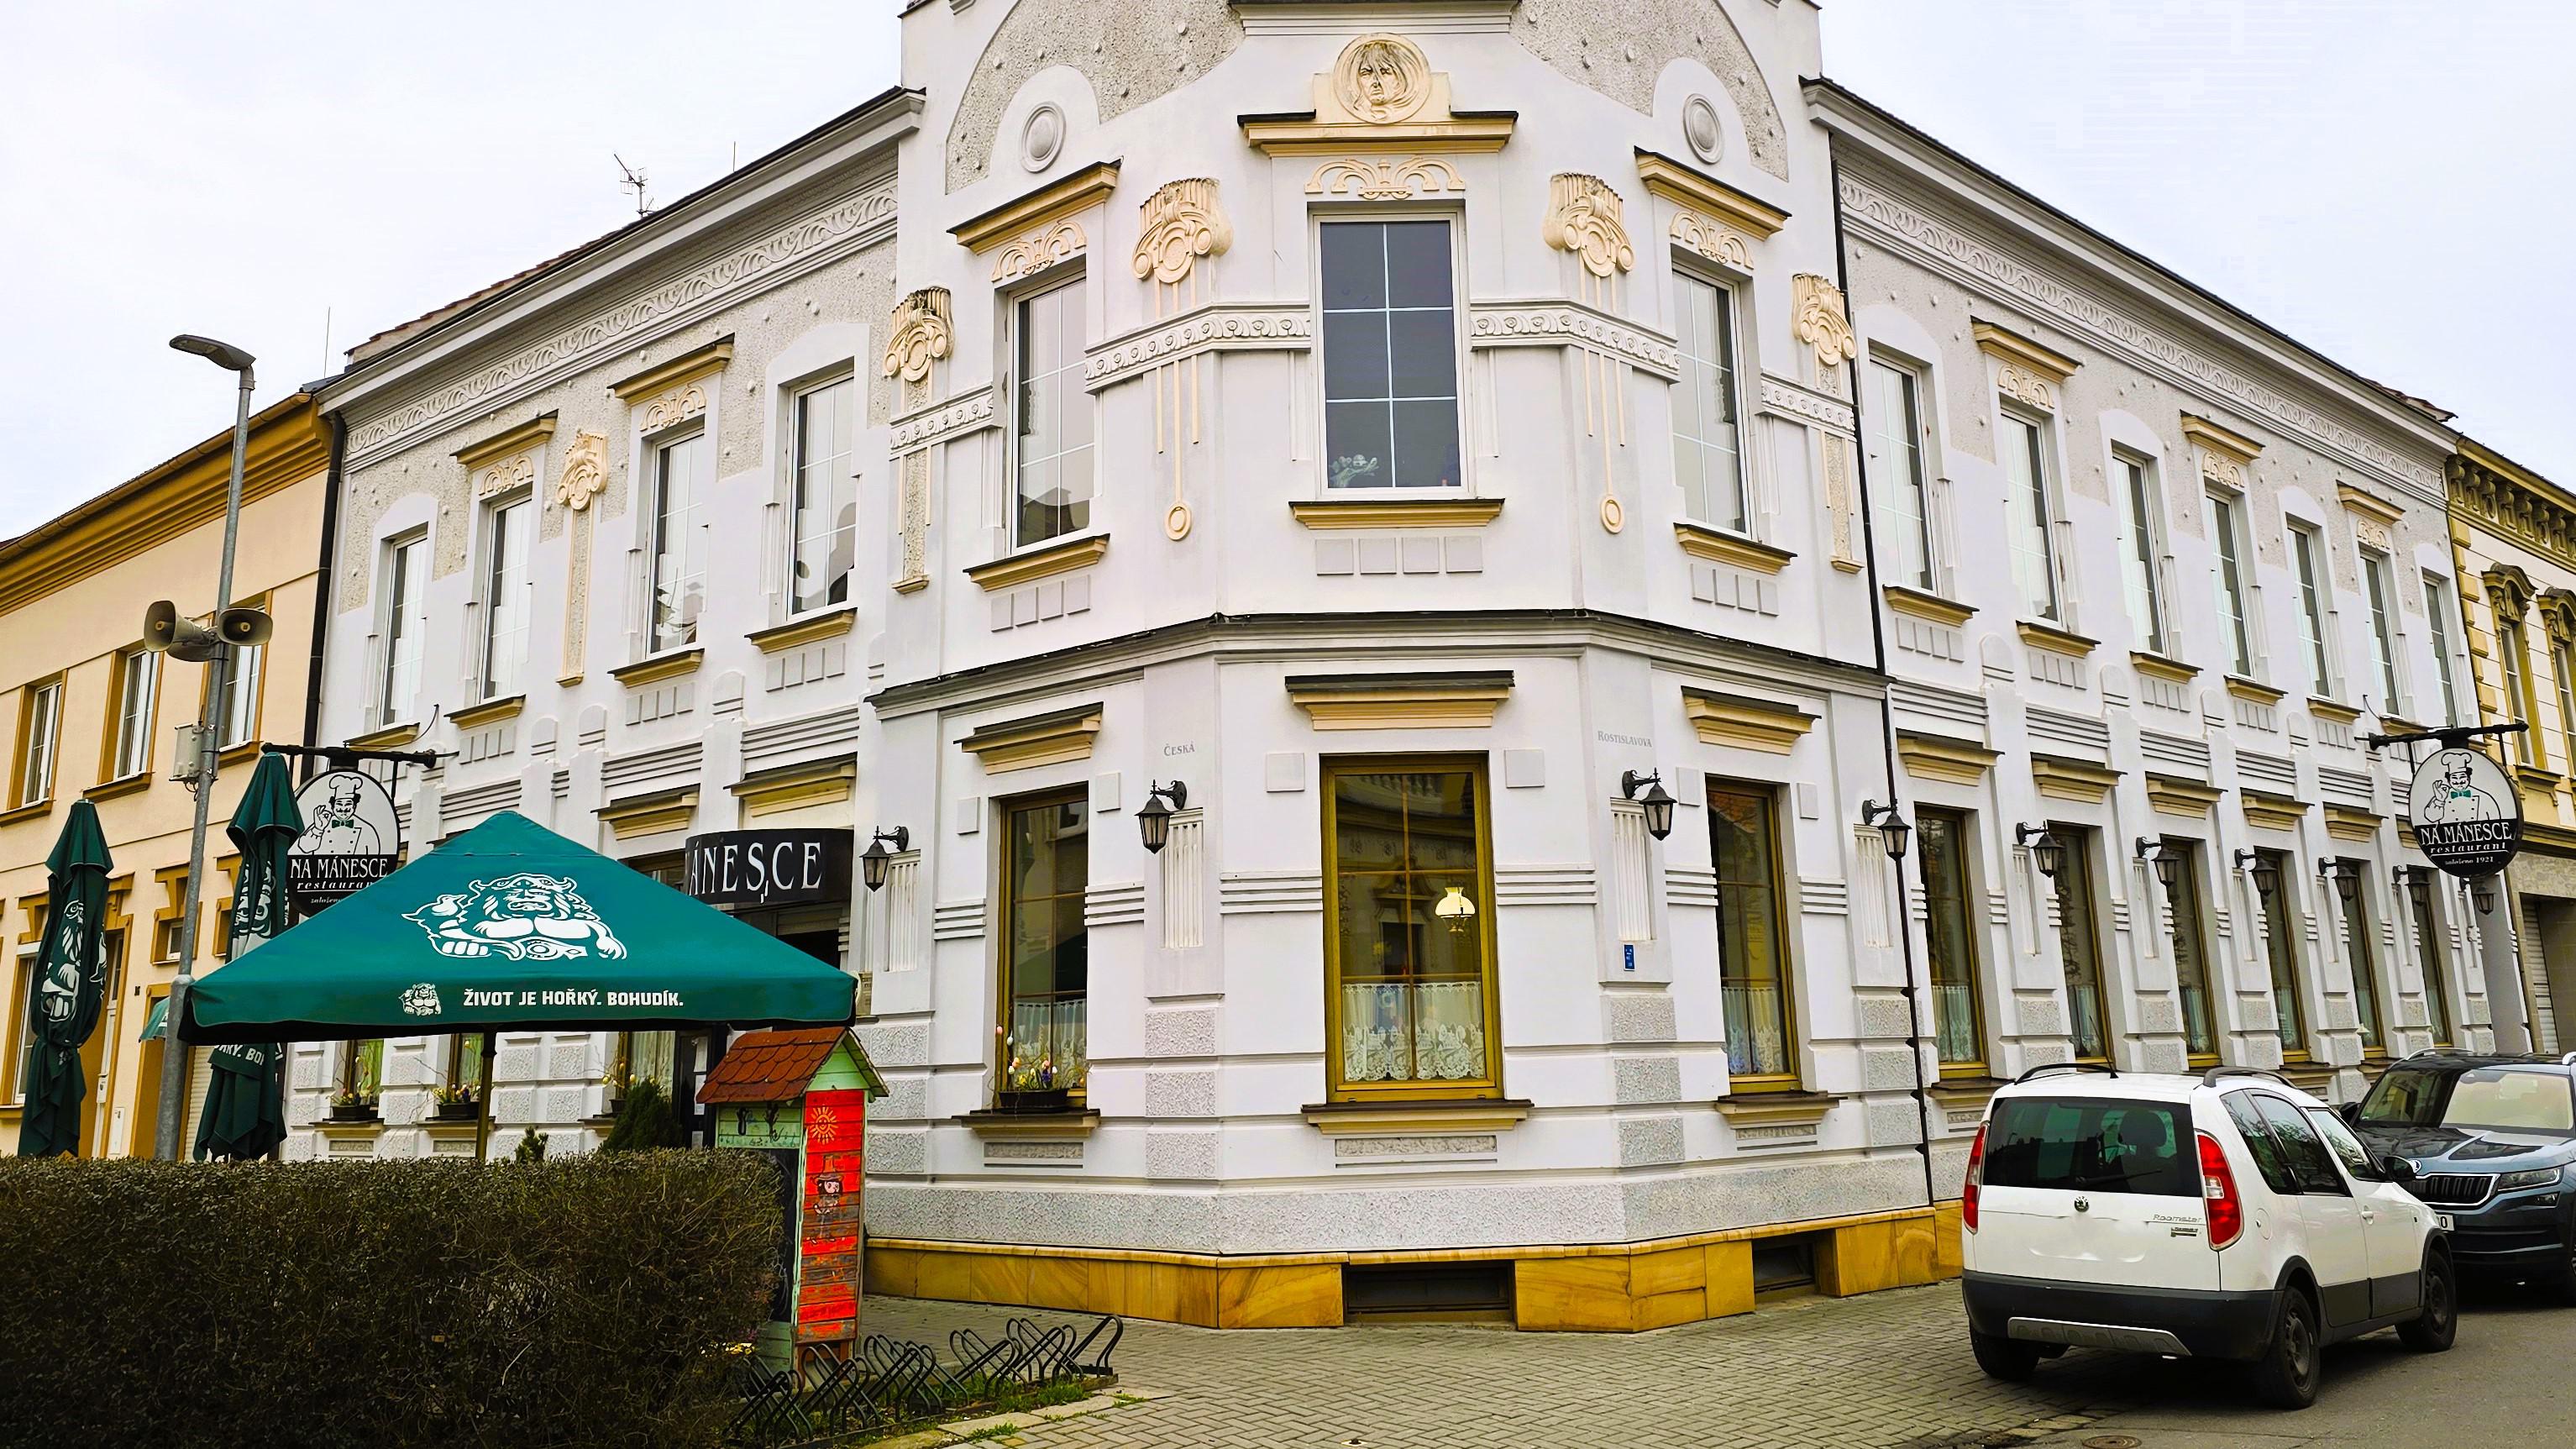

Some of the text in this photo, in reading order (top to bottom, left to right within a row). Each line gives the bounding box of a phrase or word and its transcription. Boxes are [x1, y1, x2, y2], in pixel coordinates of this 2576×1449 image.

[2420, 822, 2512, 846] NA MÁNESCE
[2430, 842, 2506, 853] restaurant
[291, 855, 387, 879] NA MÁNESCE
[463, 988, 685, 1006] ŽIVOT JE HOŘKÝ. BOHUDÍK.
